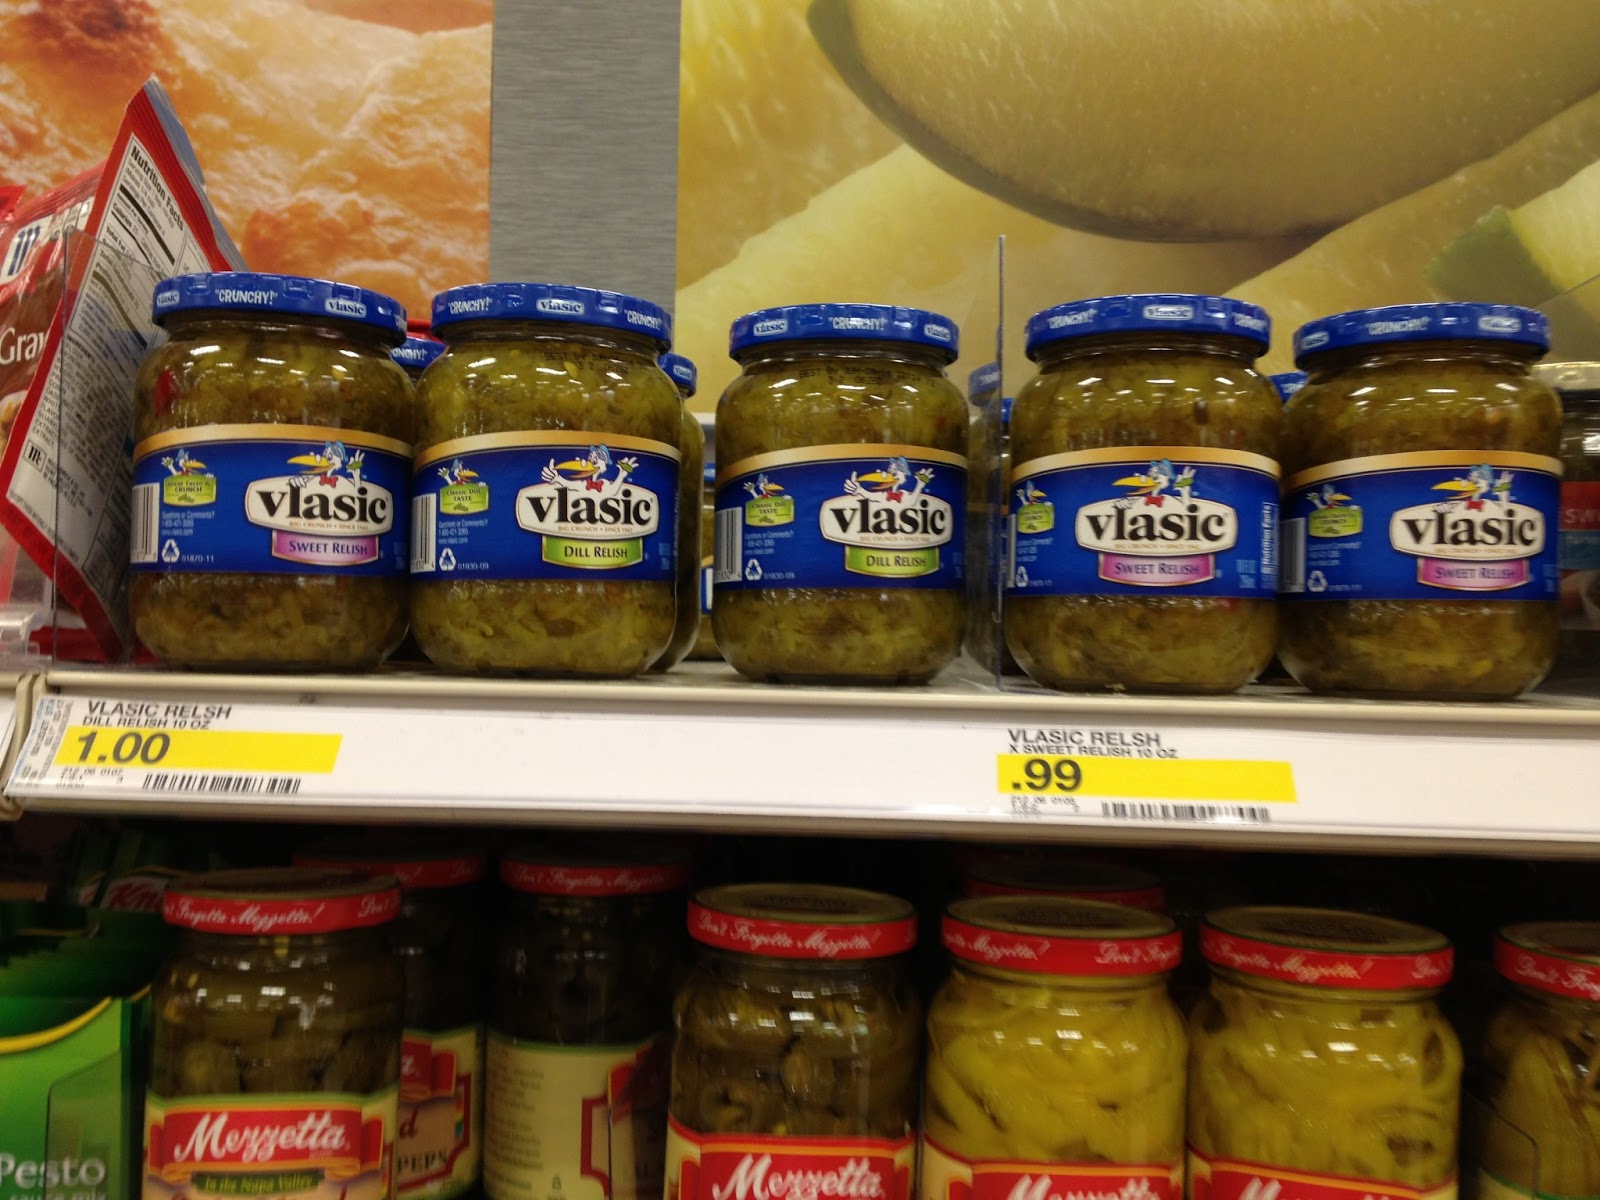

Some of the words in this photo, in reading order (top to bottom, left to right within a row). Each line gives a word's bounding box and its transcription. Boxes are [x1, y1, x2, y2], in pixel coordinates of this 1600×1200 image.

[131, 145, 166, 200] Nutrition
[165, 199, 184, 231] Facts
[328, 300, 365, 317] vlasic
[540, 299, 581, 313] vlasic
[256, 484, 387, 524] vlasic
[526, 487, 651, 526] vlasic
[830, 498, 945, 535] vlasic
[1086, 503, 1226, 542] vlasic
[1402, 509, 1535, 546] vlasic
[288, 540, 329, 553] SWEET
[332, 542, 368, 555] RELISH
[564, 545, 590, 558] DILL
[594, 546, 628, 558] RELISH
[866, 555, 891, 567] DILL
[894, 555, 926, 567] RELISH
[1114, 562, 1155, 575] SWEET
[83, 716, 113, 727] DILL
[116, 717, 168, 729] RELISH
[172, 719, 187, 729] 10
[190, 720, 211, 730] OZ
[87, 700, 159, 718] VLASIC
[165, 702, 233, 720] RELSH
[77, 730, 171, 765] 1.00
[1008, 729, 1084, 745] VLASIC
[1089, 731, 1162, 747] RELSH
[1008, 744, 1020, 754] X
[1023, 745, 1076, 756] SWEET
[1078, 746, 1131, 758] RELISH
[1137, 748, 1152, 758] 10
[1156, 749, 1179, 759] OZ
[1012, 758, 1082, 792] .99
[174, 1111, 347, 1163] Mezzetta
[0, 1152, 106, 1189] Pesto
[712, 1153, 883, 1200] Mezzetta
